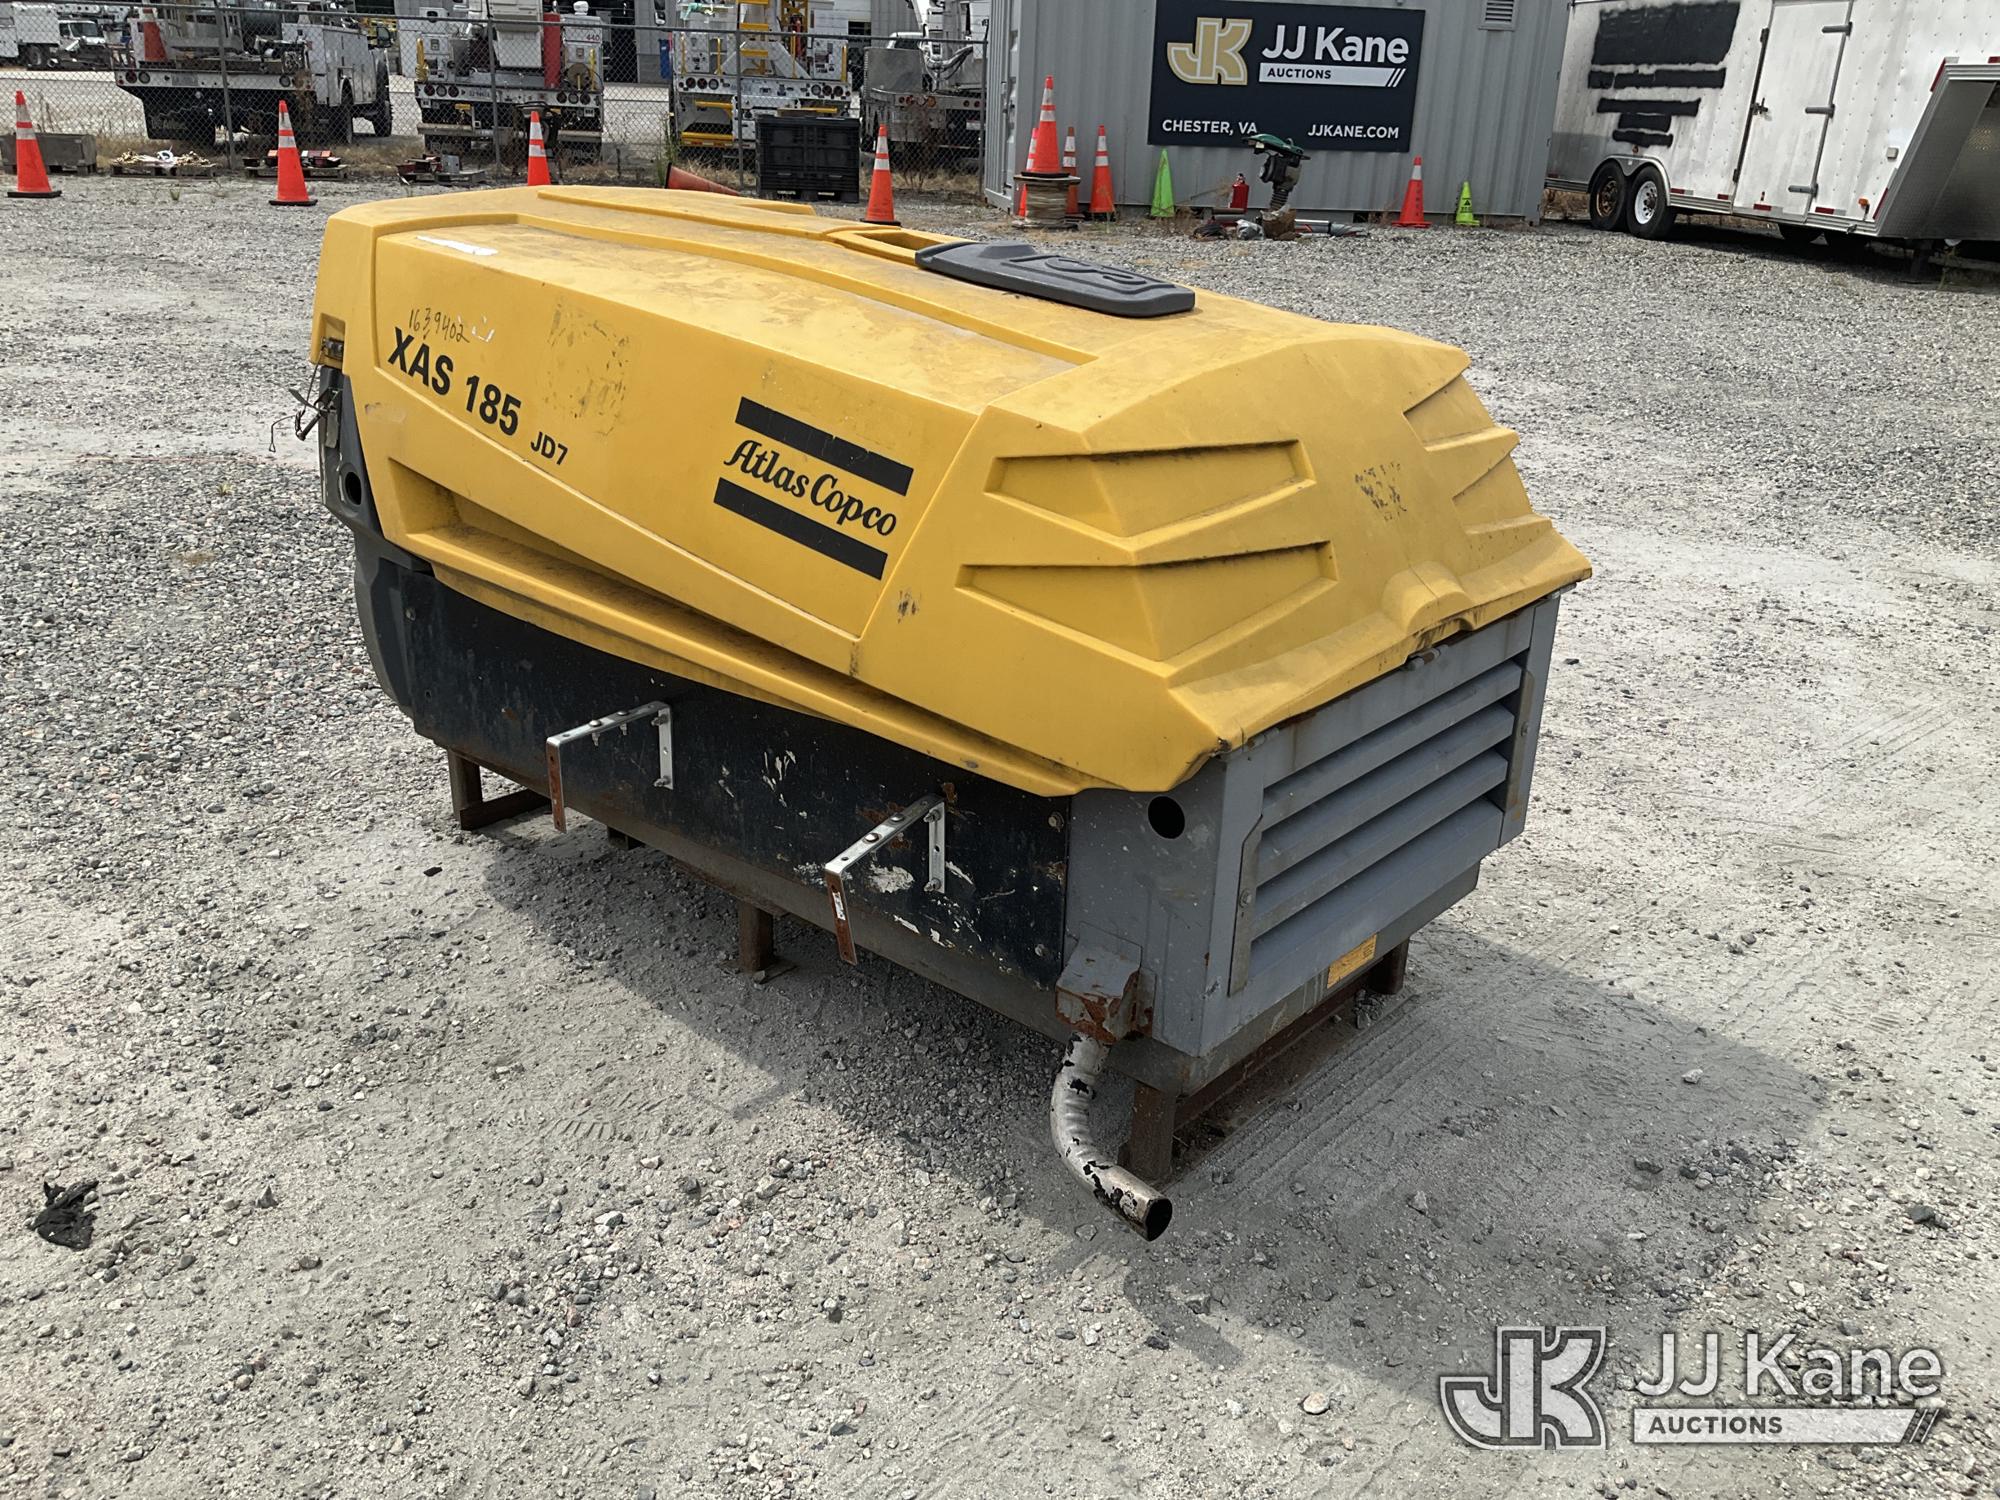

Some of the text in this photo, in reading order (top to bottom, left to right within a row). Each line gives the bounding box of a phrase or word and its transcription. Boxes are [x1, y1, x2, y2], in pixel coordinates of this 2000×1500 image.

[1262, 25, 1409, 64] JJ Kane
[1267, 68, 1332, 80] AUCTIONS
[1162, 119, 1257, 135] CHESTER, VA
[1308, 124, 1399, 139] JJKANE.COM
[388, 327, 568, 466] XAS 185 JD7
[723, 439, 897, 536] Atlas Copco
